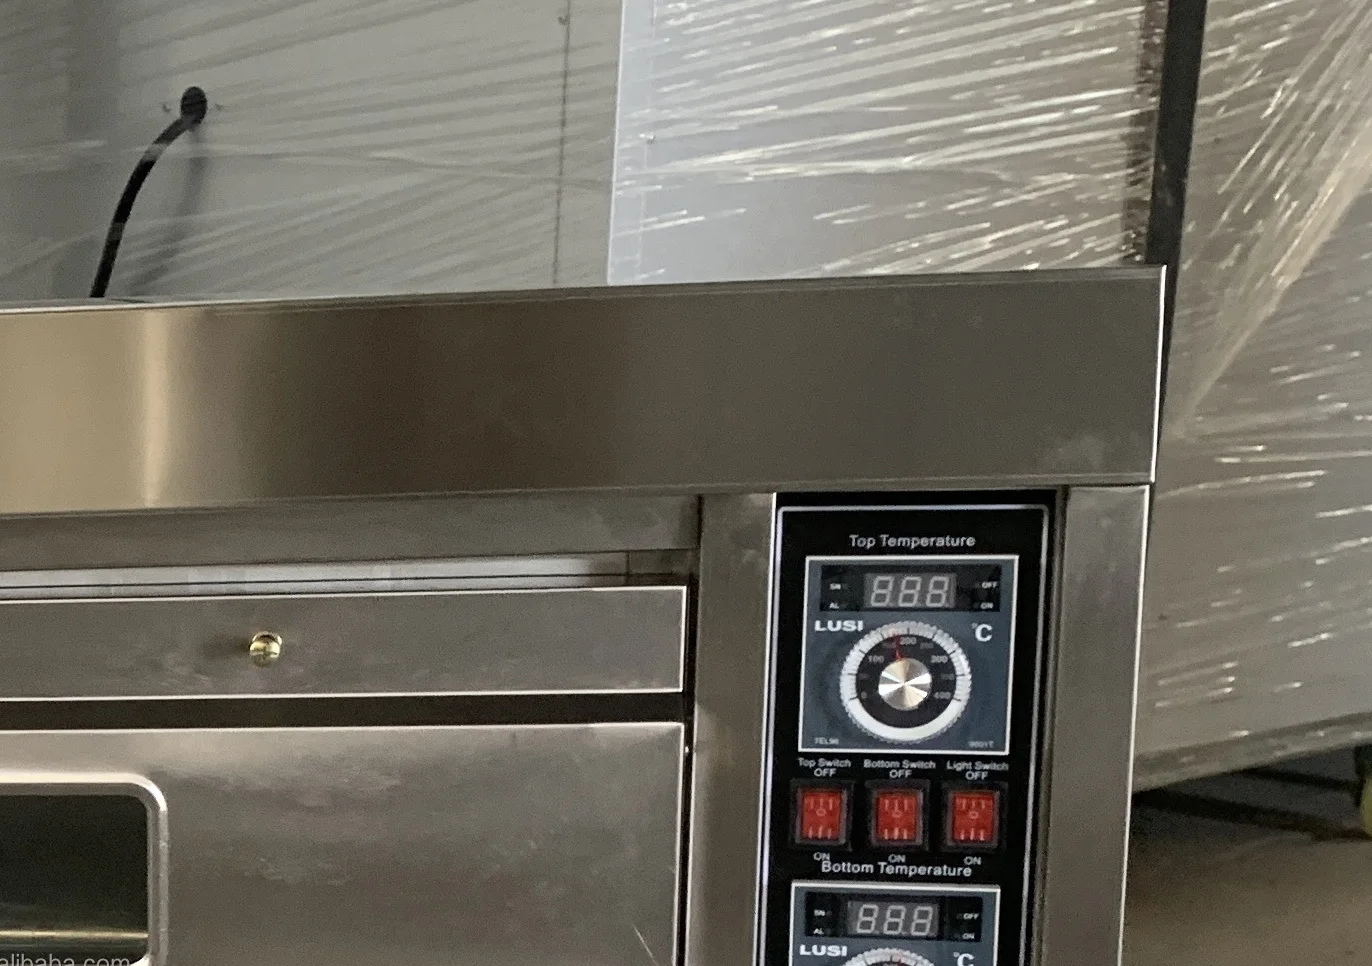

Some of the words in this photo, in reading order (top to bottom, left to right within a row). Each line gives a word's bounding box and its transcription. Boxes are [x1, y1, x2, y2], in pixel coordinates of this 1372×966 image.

[849, 535, 876, 549] Top
[879, 534, 976, 548] Temperature
[981, 581, 998, 589] OFF
[814, 620, 864, 632] LUSI
[798, 758, 817, 768] Top
[818, 758, 851, 767] Switch
[864, 759, 900, 769] Bottom
[902, 760, 936, 769] Switch
[946, 760, 973, 771] Light
[974, 761, 1009, 771] Switch
[814, 768, 837, 777] OFF
[889, 769, 913, 778] OFF
[965, 771, 989, 780] OFF
[888, 854, 905, 864] ON
[963, 856, 981, 866] ON
[821, 861, 874, 874] Bottom
[878, 862, 972, 877] Temperature
[799, 945, 848, 957] LUSI
